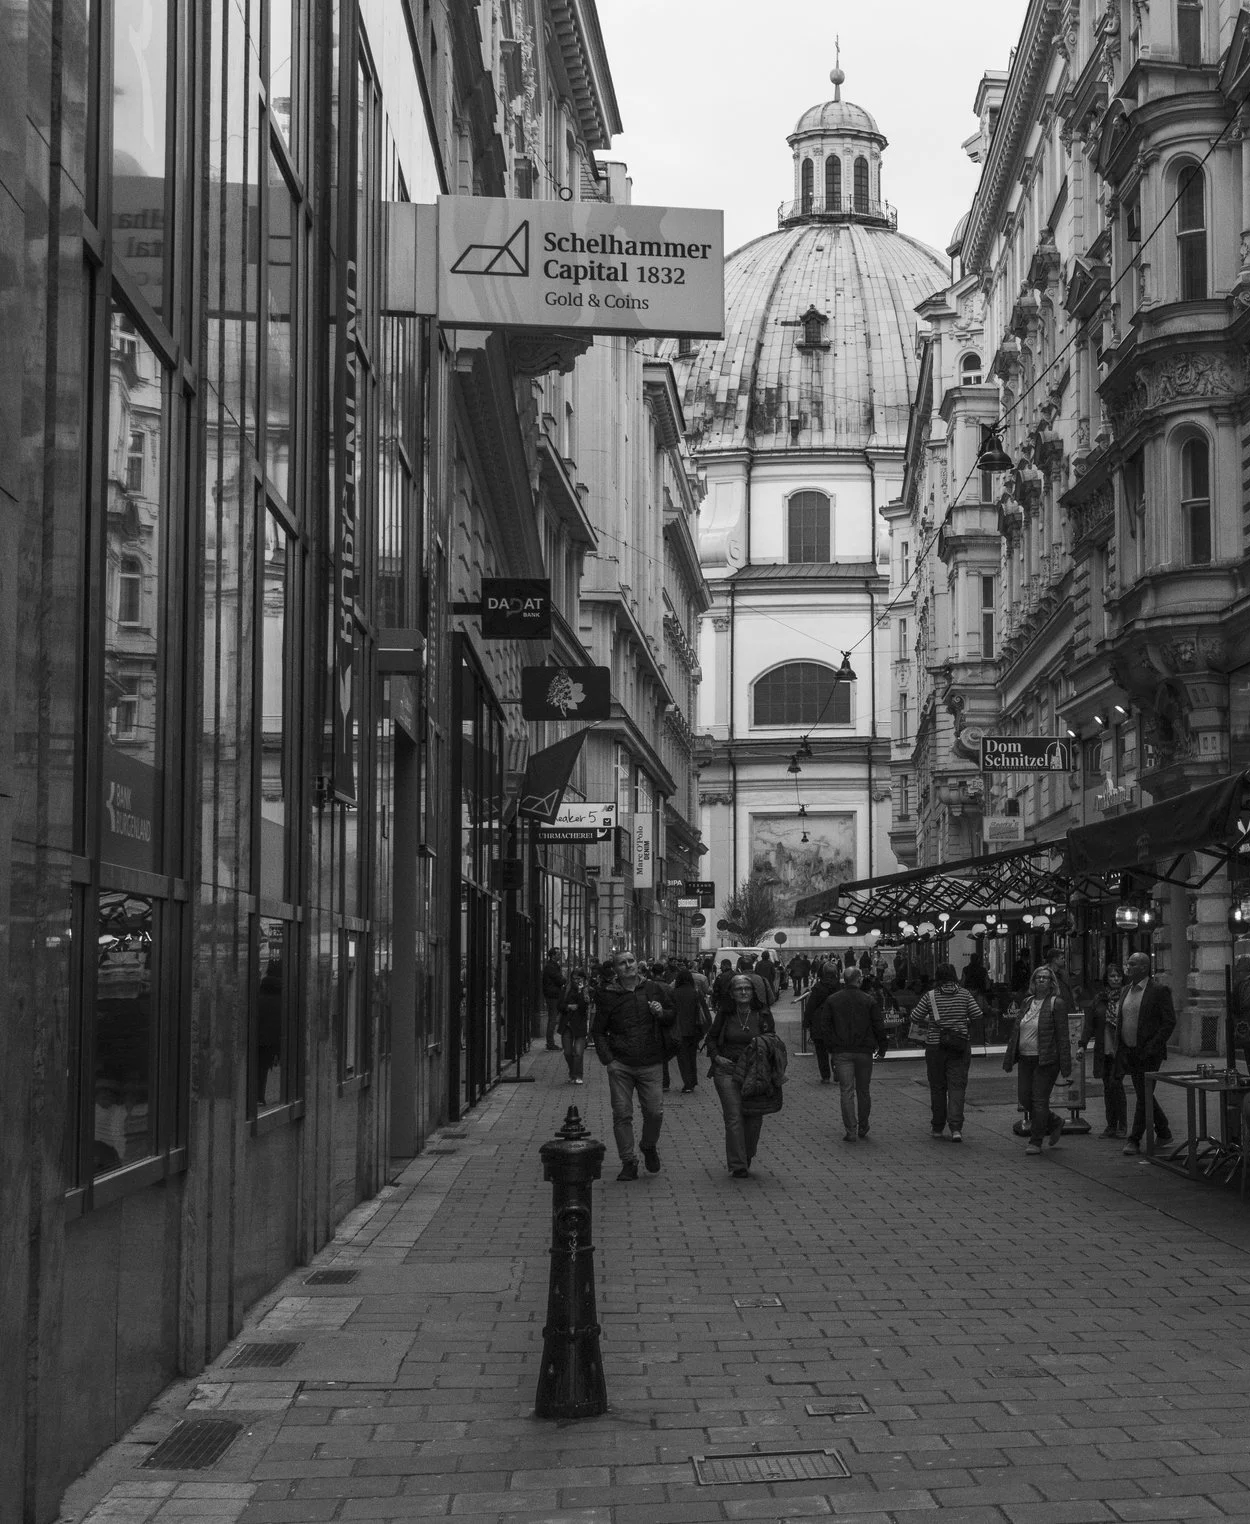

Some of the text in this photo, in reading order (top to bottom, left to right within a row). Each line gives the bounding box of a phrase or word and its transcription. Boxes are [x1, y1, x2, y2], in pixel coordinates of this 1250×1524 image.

[543, 231, 712, 261] Schelhammer
[543, 259, 686, 285] Capital 1832
[545, 291, 650, 310] Gold & Coins
[986, 739, 1022, 753] Dom
[985, 753, 1049, 767] Schnitzel
[555, 808, 598, 824] eaker 5
